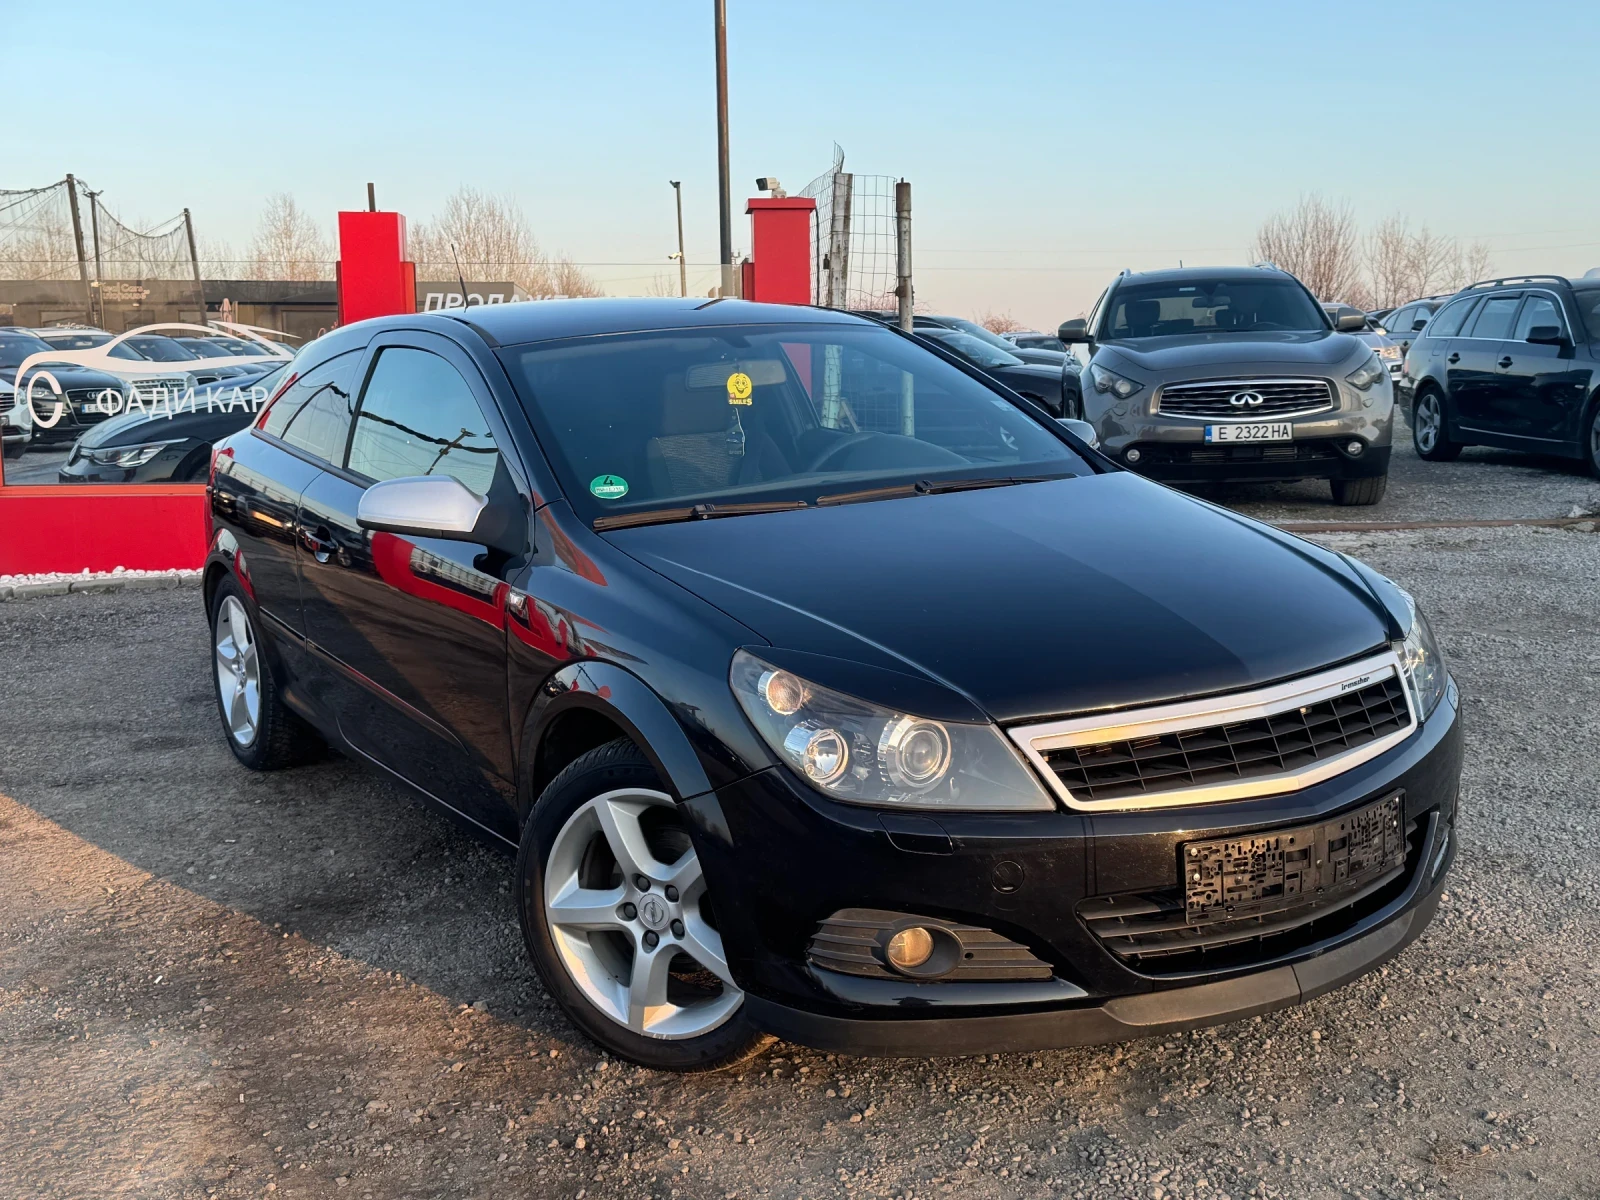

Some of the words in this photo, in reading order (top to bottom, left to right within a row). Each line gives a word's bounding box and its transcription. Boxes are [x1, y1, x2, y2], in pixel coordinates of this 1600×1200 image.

[97, 388, 196, 419] ФАДИ
[206, 387, 269, 413] КАР
[1219, 427, 1228, 440] E
[1235, 426, 1269, 440] 2322
[603, 475, 615, 487] 4
